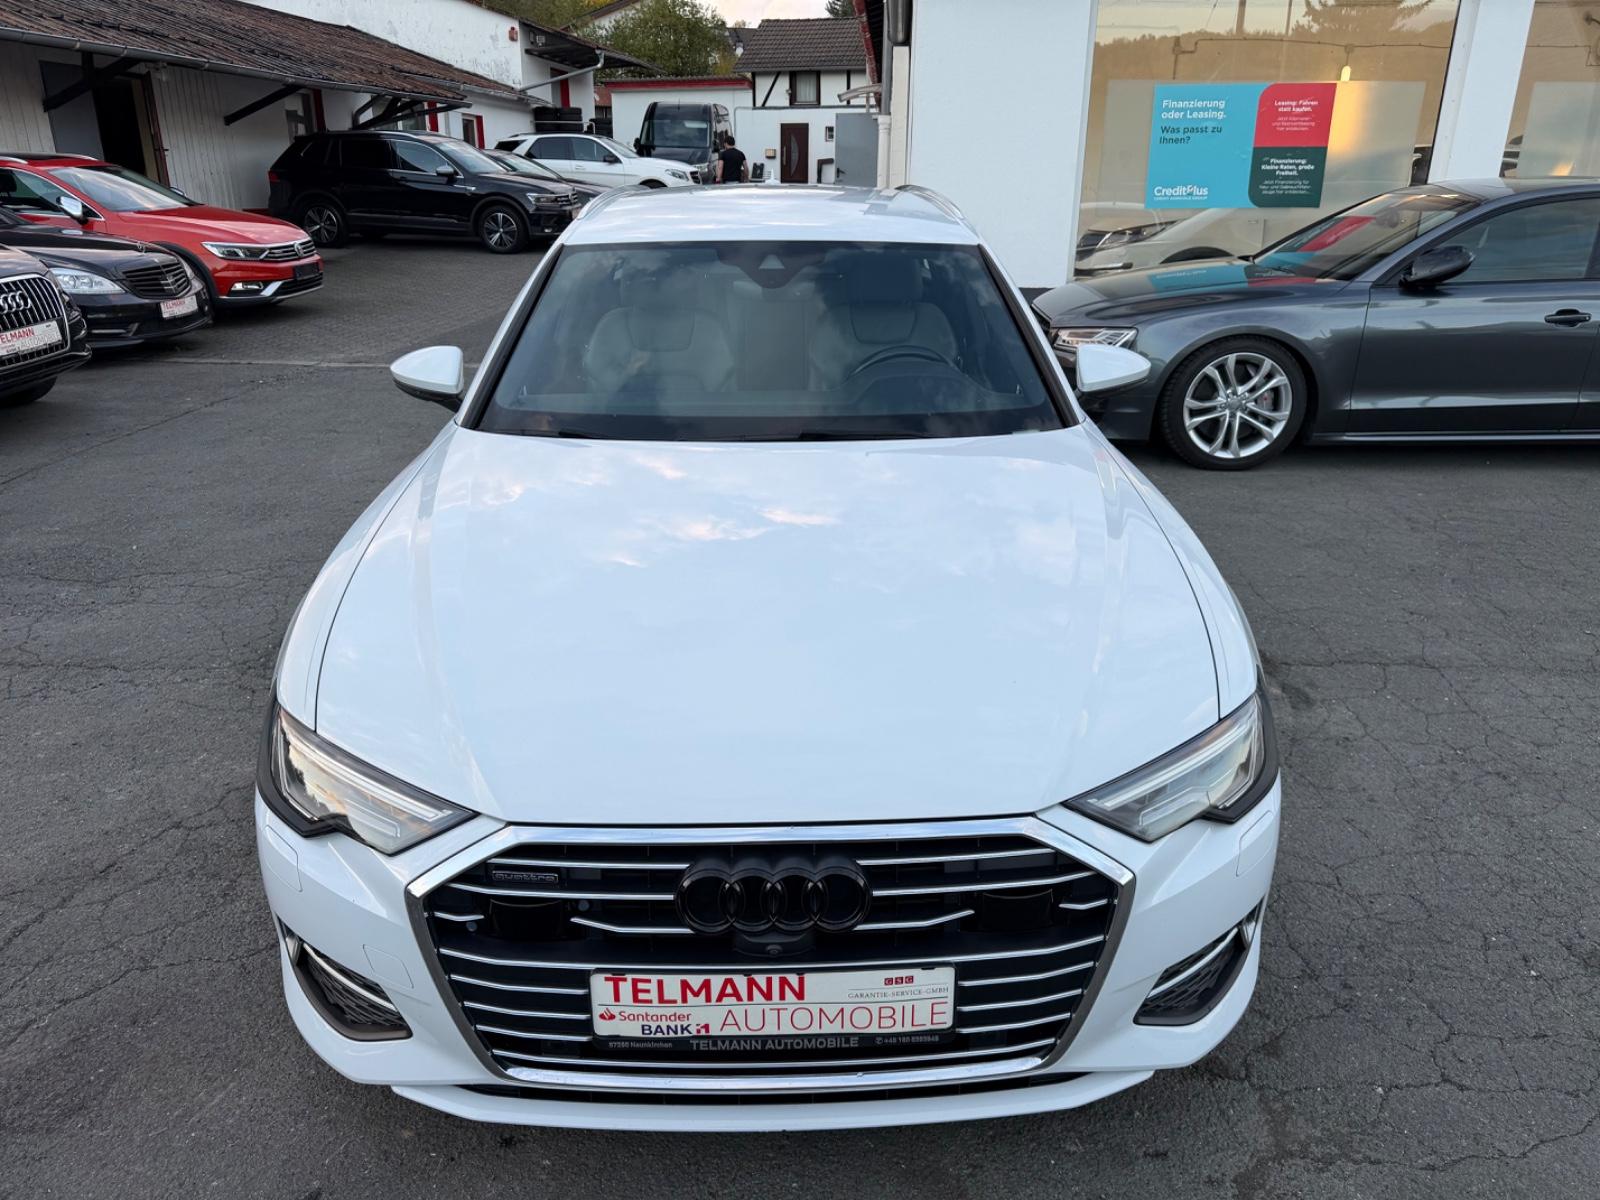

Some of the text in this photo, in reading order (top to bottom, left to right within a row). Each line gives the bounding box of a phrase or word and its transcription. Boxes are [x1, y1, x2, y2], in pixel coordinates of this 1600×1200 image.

[1162, 100, 1226, 109] Finanzierung
[1161, 110, 1227, 119] oder Leasing.
[1161, 126, 1223, 135] Was passt zu
[1159, 136, 1191, 145] Ihnen?
[1153, 185, 1209, 196] CreditPlus
[0, 327, 35, 344] ELMANN
[494, 873, 556, 882] quattro
[884, 975, 914, 986] GSG
[604, 974, 806, 1005] TELMANN
[618, 1010, 692, 1022] Santander
[720, 1001, 949, 1033] AUTOMOBILE
[690, 1036, 859, 1051] TELMANN AUTOMOBILE
